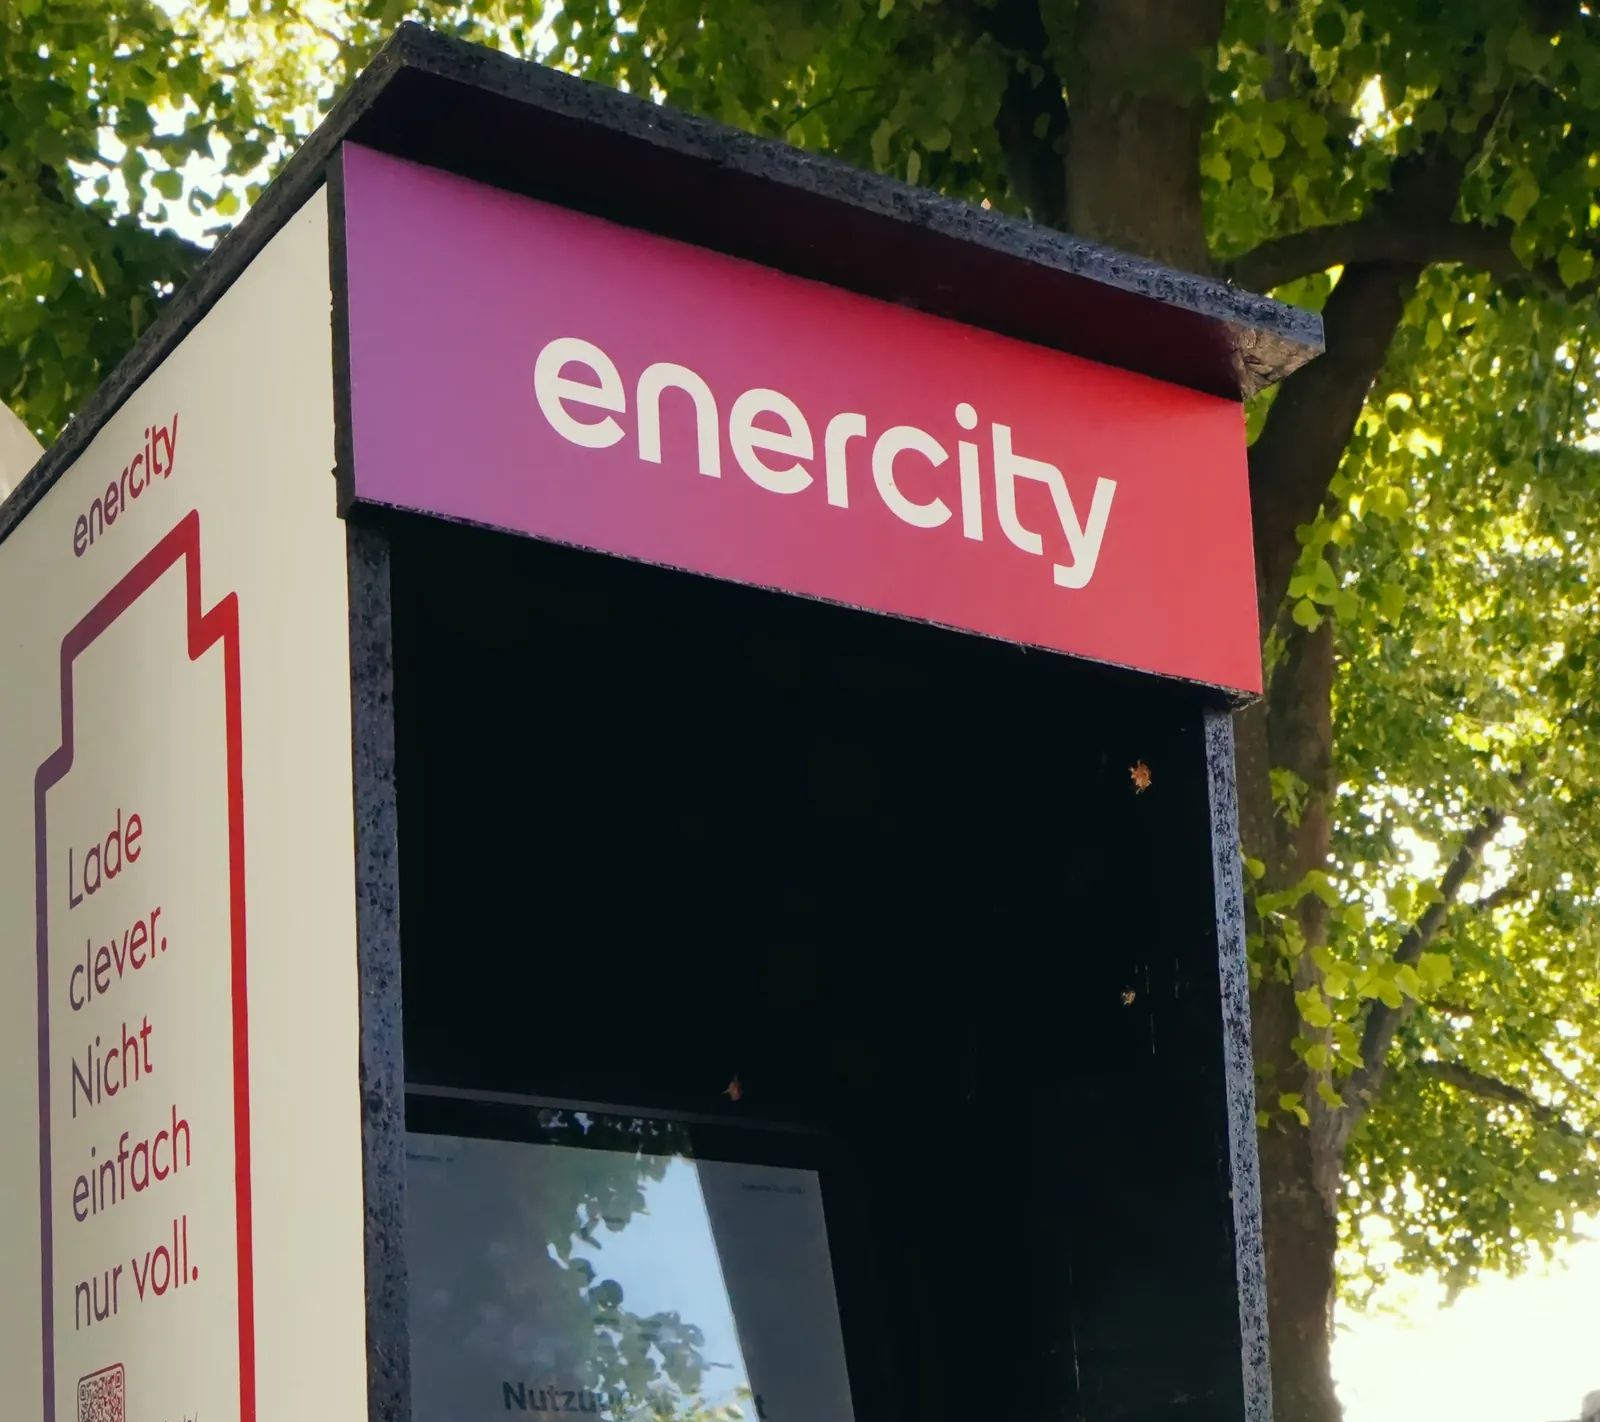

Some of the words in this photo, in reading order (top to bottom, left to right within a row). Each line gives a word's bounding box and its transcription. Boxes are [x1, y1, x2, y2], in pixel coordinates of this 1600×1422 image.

[72, 412, 179, 557] enercity
[534, 337, 1117, 589] enercity
[68, 807, 143, 910] Lade
[69, 907, 168, 1011] clever.
[71, 1014, 153, 1118] Nicht
[72, 1104, 191, 1222] einfach
[75, 1264, 123, 1331] nur
[132, 1214, 199, 1302] voll.
